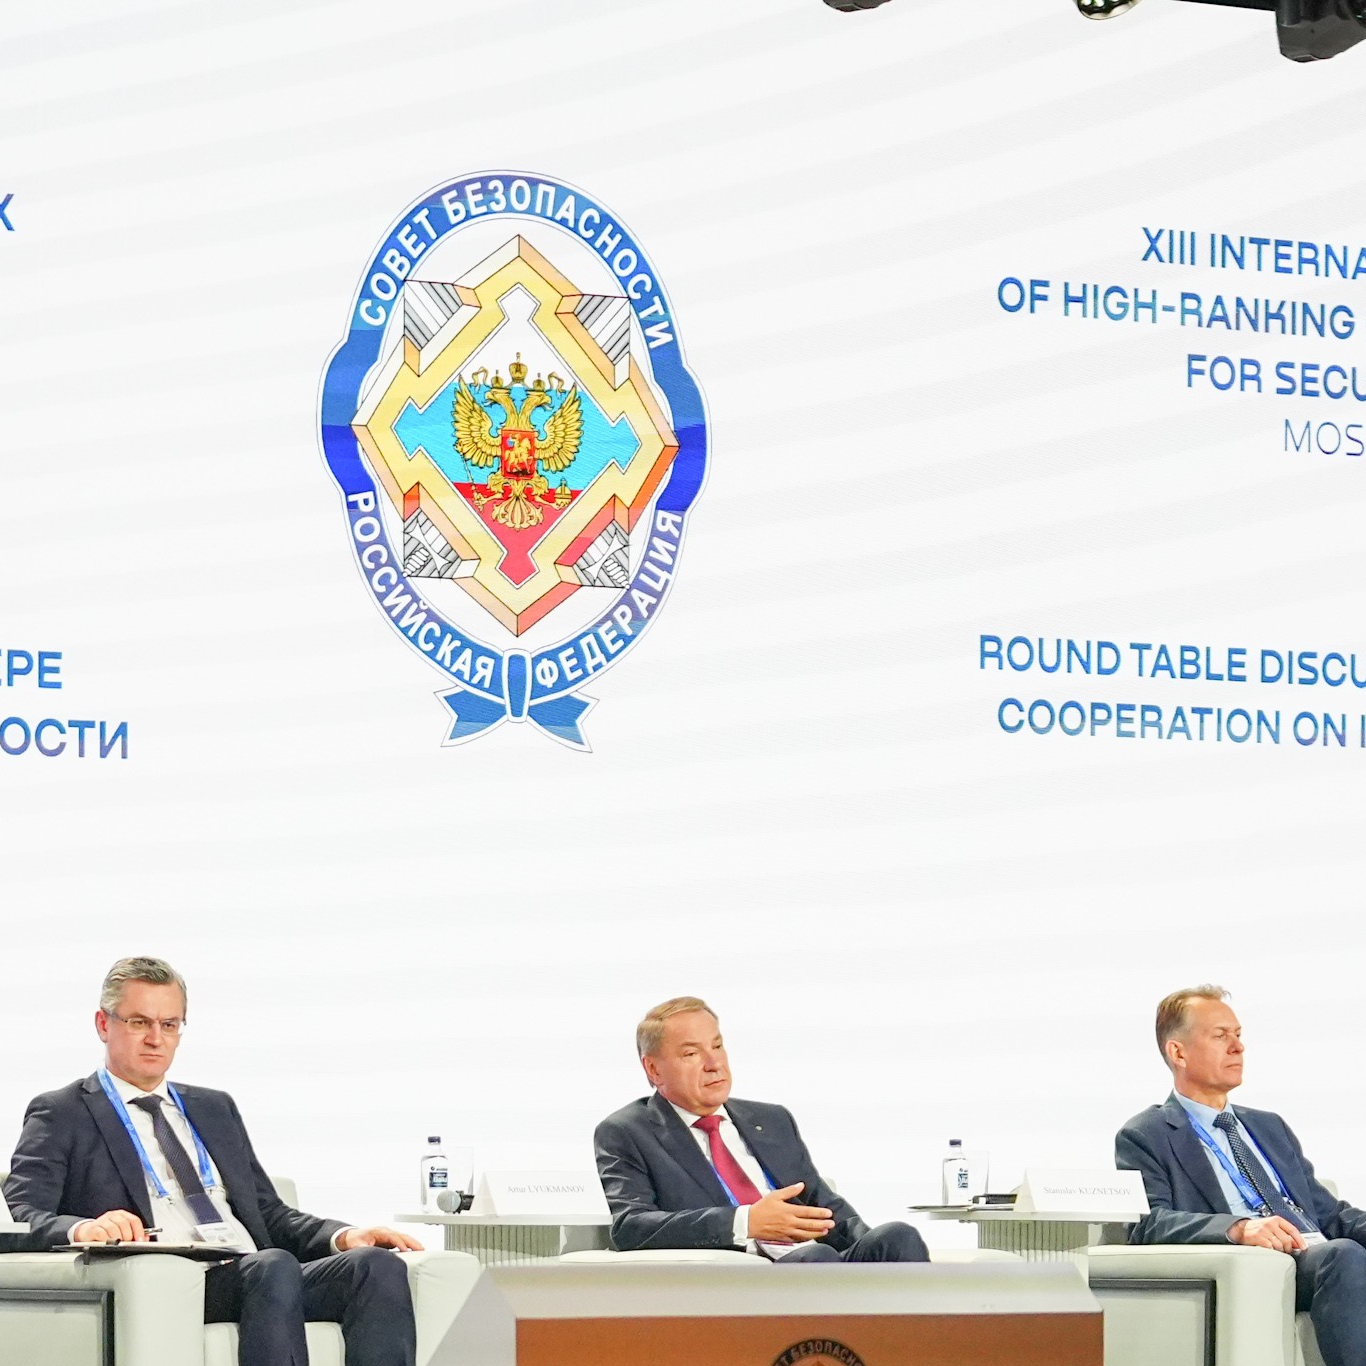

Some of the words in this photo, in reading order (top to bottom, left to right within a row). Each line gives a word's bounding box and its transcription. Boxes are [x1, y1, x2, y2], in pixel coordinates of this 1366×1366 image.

[358, 211, 439, 328] СОВЕТ
[441, 178, 674, 350] БЕЗОПАСНОСТИ
[1142, 227, 1196, 266] XIII
[998, 276, 1051, 314] OF
[1063, 281, 1355, 340] HIGH-RANKING
[1187, 354, 1263, 392] FOR
[347, 490, 495, 690] РОССИЙСКАЯ
[535, 510, 684, 690] ФЕДЕРАЦИЯ
[980, 634, 1122, 676] ROUND
[1130, 642, 1248, 682] TABLE
[998, 697, 1281, 744] COOPERATION
[1293, 711, 1347, 747] ON
[1043, 1186, 1076, 1195] Stanislav
[1078, 1187, 1131, 1196] KUZNETSOV
